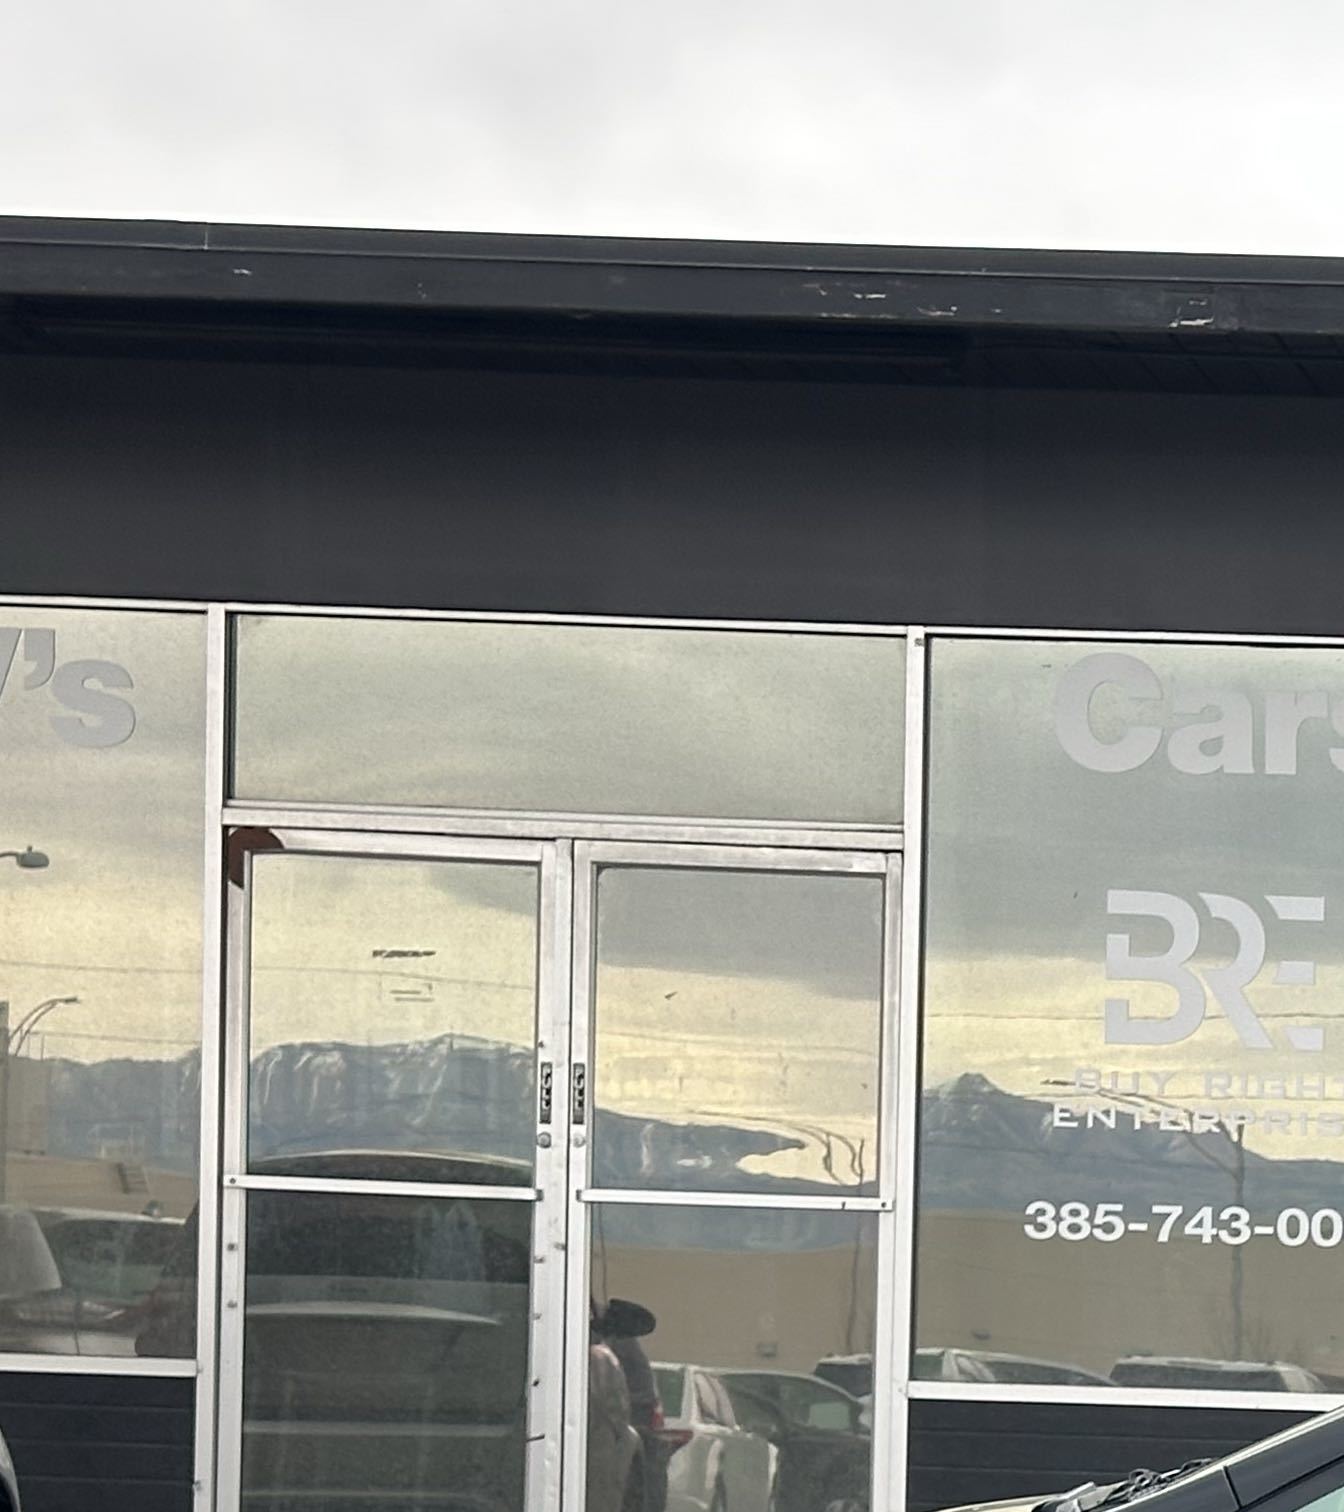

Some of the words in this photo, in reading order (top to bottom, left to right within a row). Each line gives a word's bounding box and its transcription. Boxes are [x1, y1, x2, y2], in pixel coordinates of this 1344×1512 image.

[0, 627, 136, 748] 's
[1105, 888, 1326, 1052] BRE
[1074, 1067, 1176, 1096] BUY
